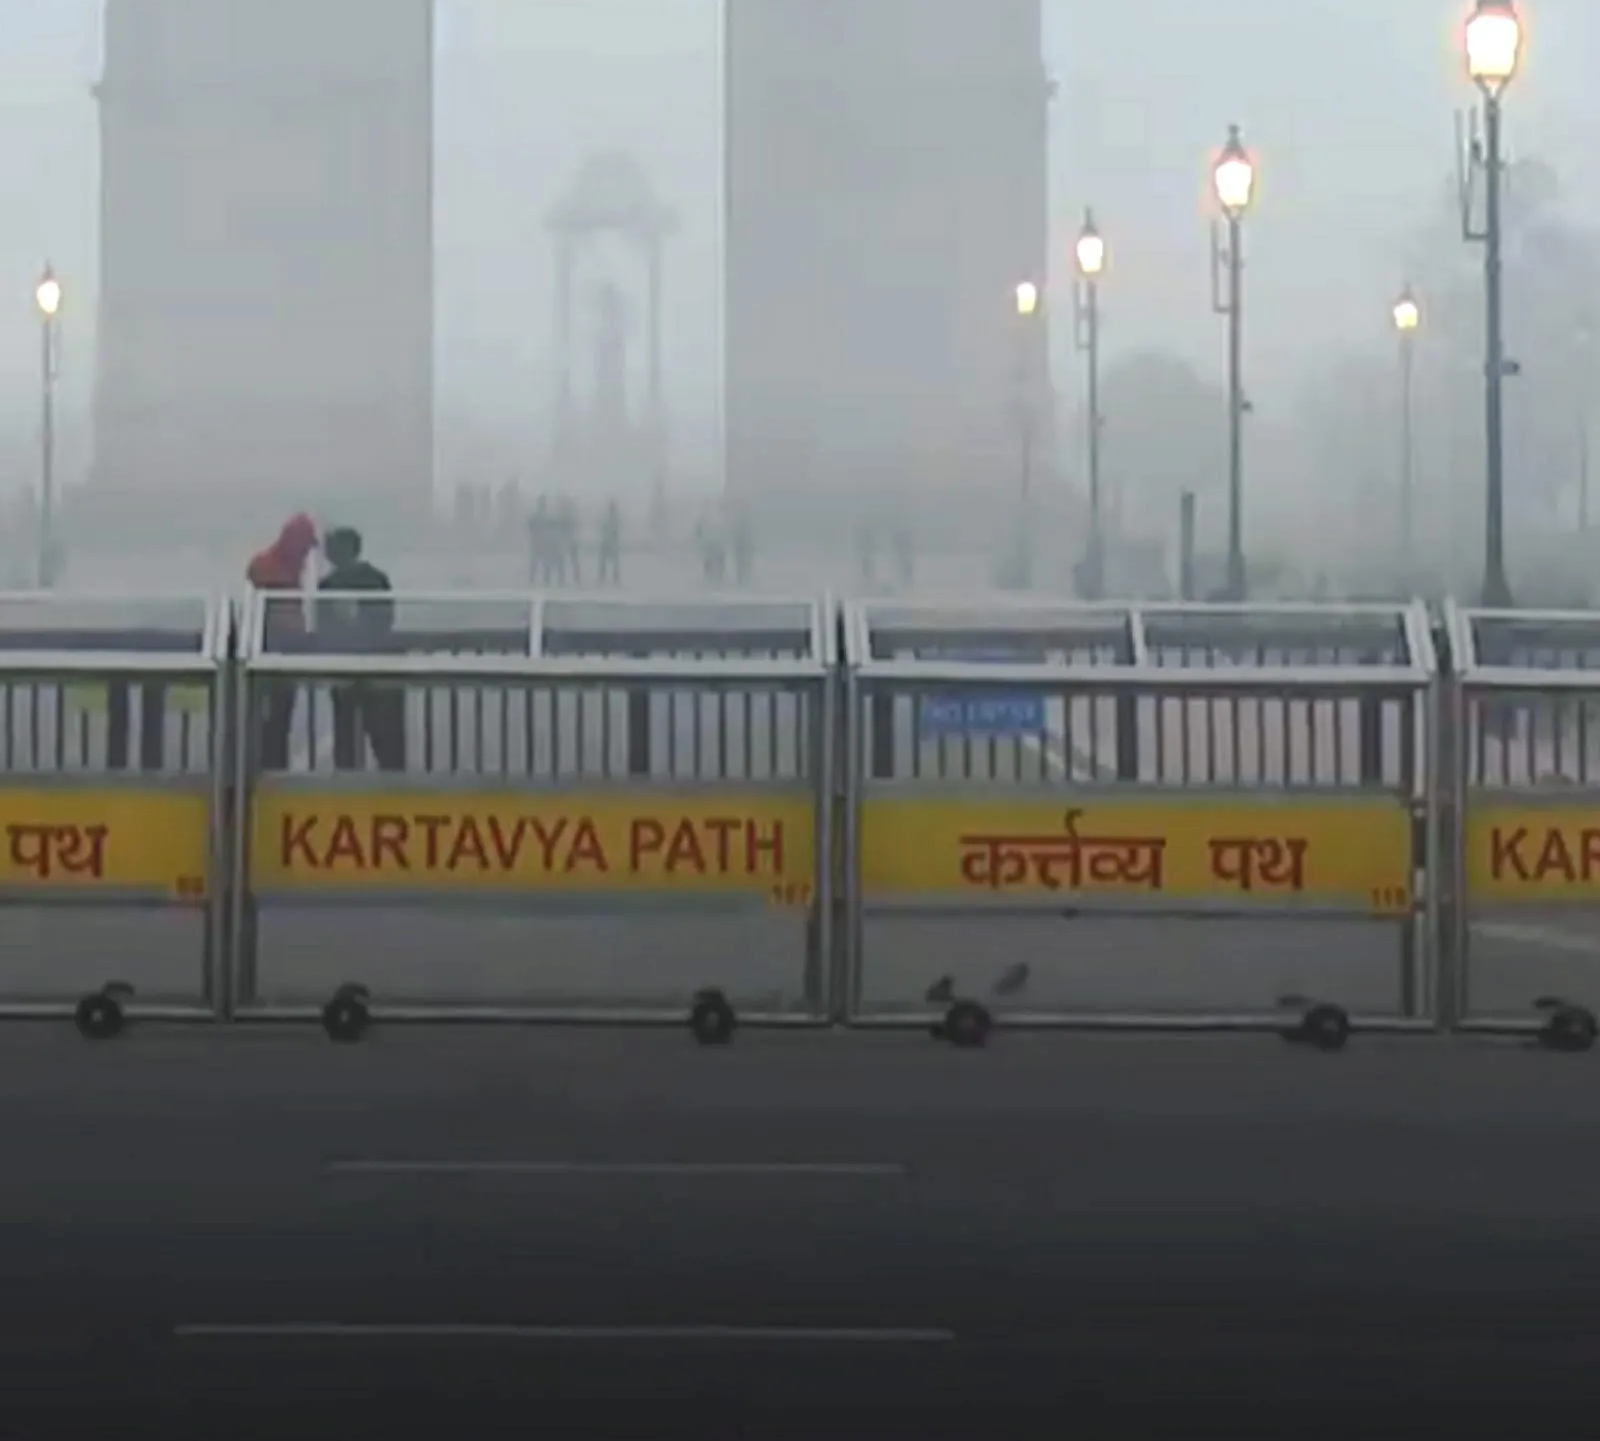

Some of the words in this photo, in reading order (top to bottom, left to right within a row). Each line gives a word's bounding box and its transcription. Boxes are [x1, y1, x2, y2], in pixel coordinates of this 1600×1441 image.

[7, 824, 109, 879] पथ
[281, 814, 609, 873] KARTAVYA
[630, 818, 785, 875] PATH
[960, 808, 1167, 891] कर्त्तव्य
[1208, 838, 1309, 892] पथ
